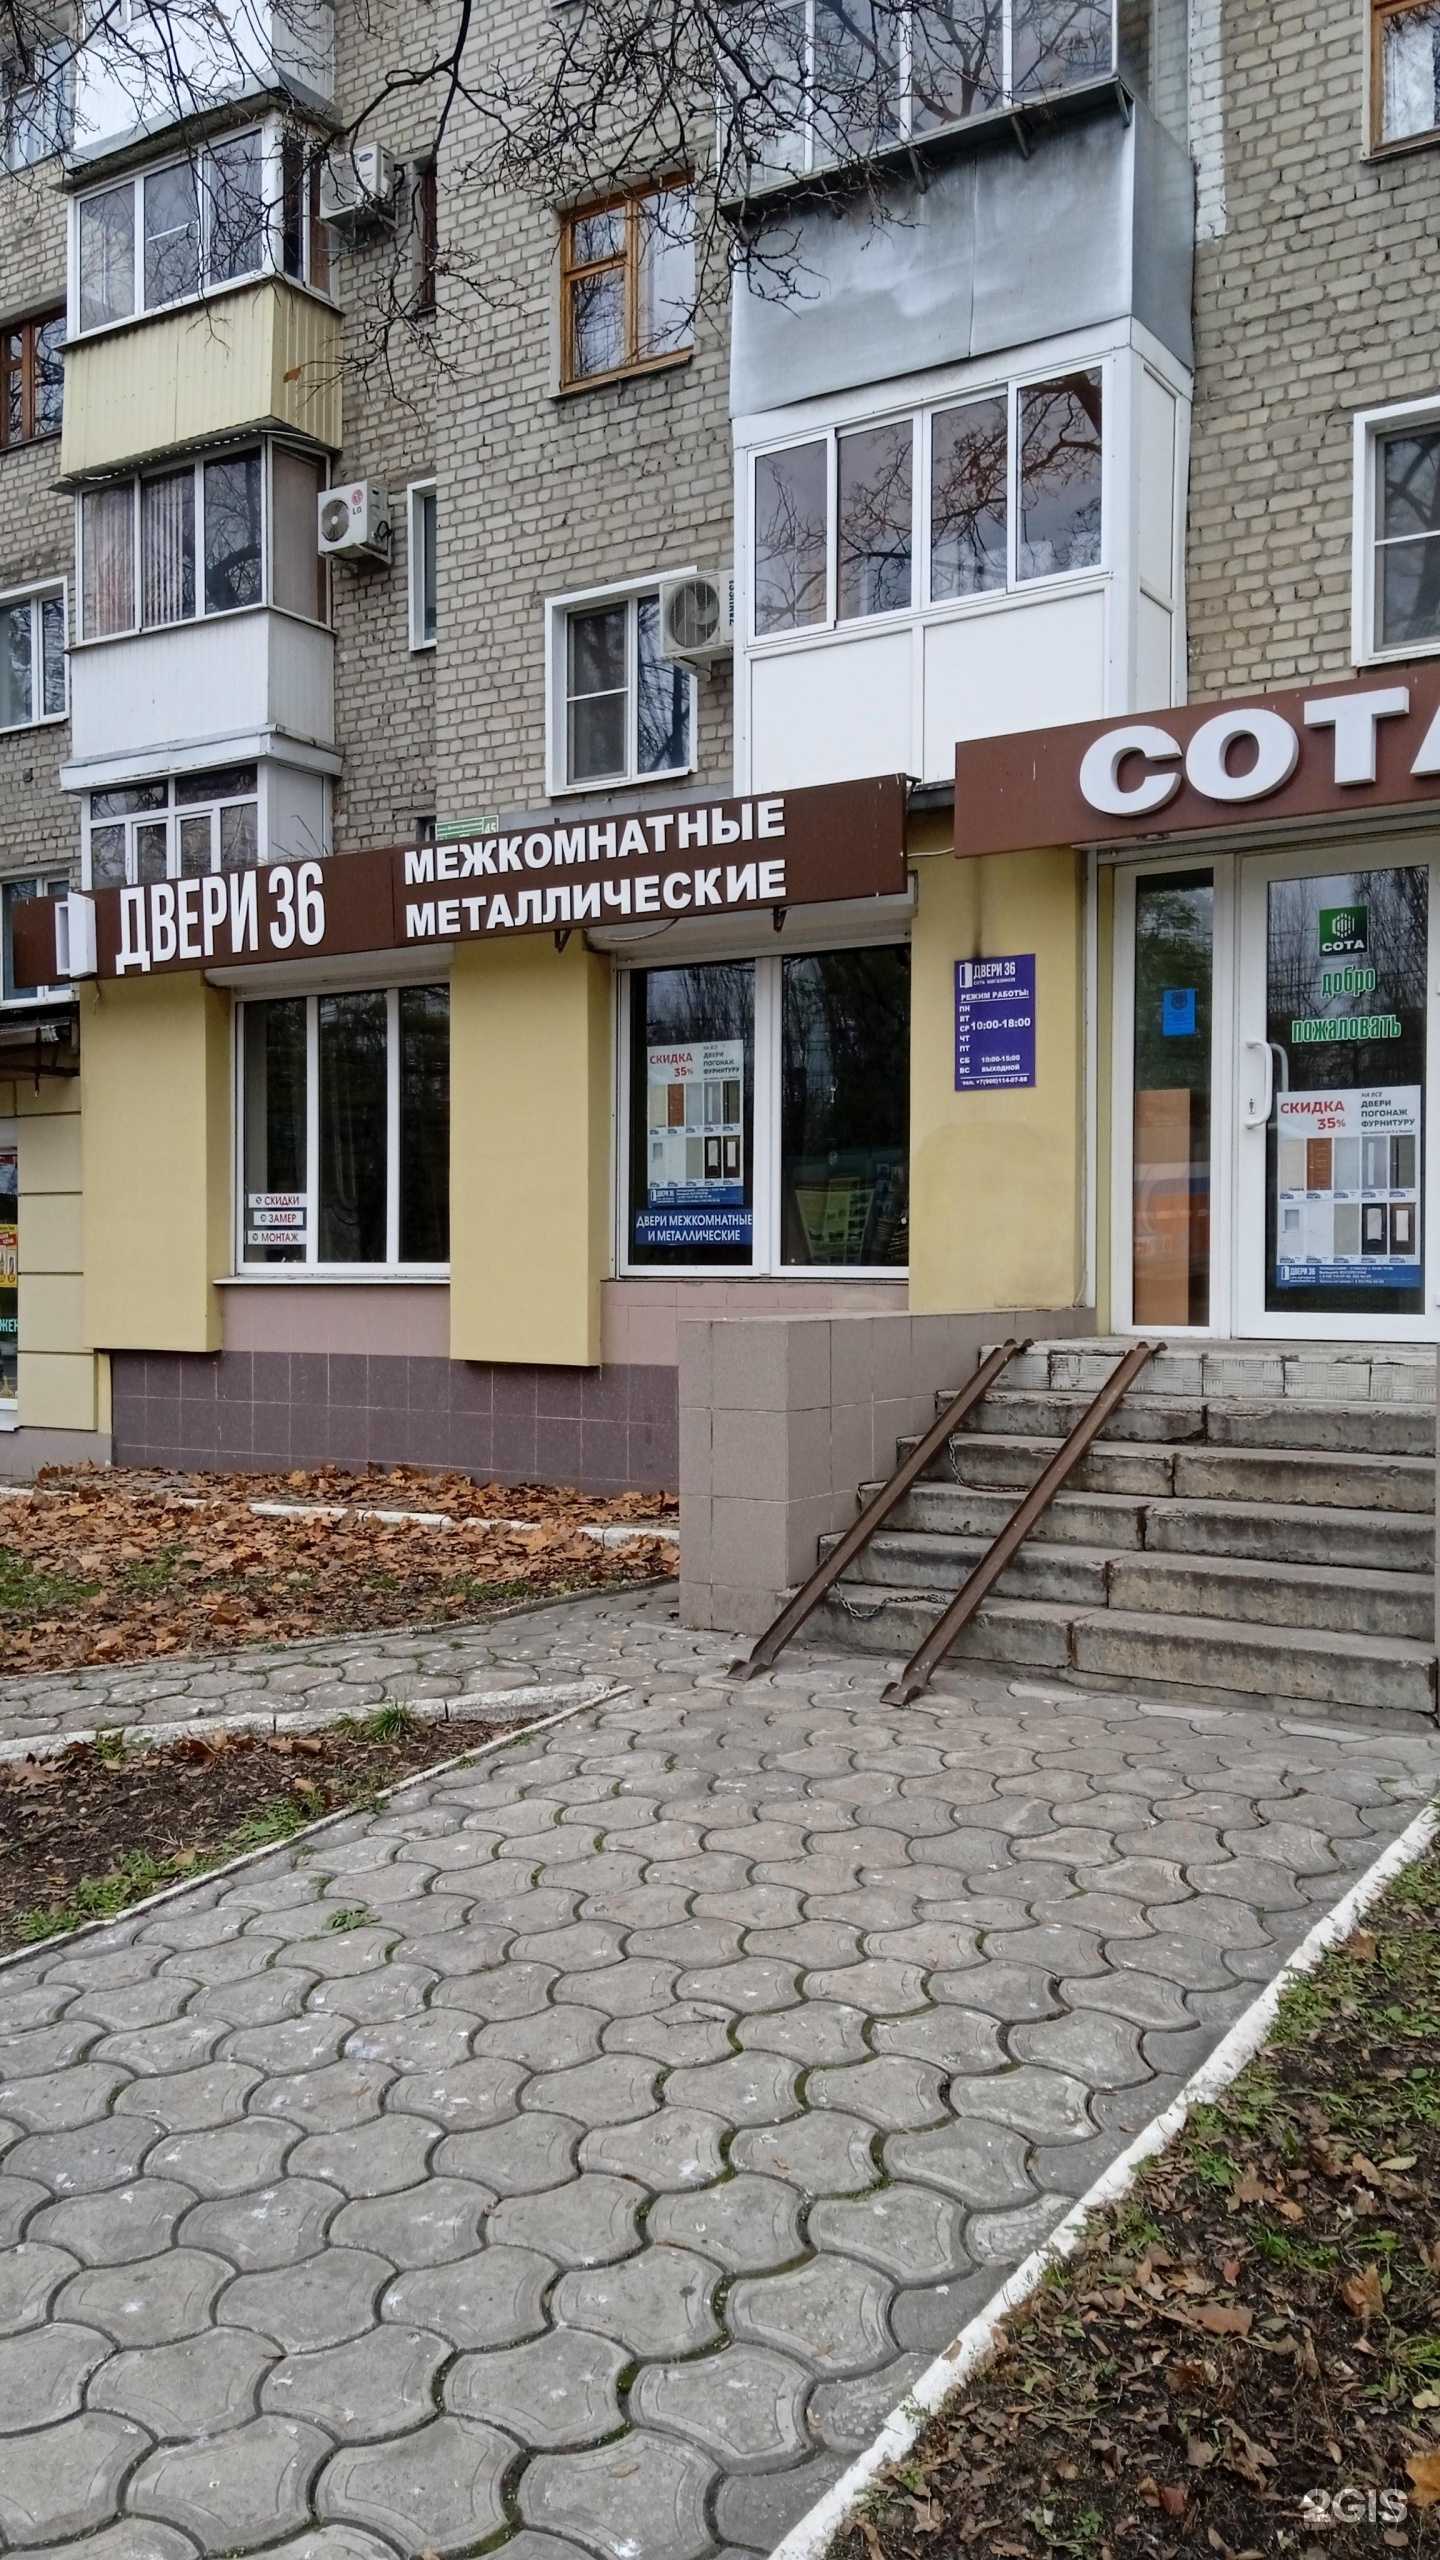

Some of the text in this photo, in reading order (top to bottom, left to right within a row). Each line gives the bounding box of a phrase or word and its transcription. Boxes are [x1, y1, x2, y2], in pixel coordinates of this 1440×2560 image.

[352, 506, 362, 515] LG
[404, 799, 785, 885] МЕЖКОМНАТНЫЕ
[406, 859, 787, 938] МЕТАЛЛИЧЕСКИЕ
[115, 861, 325, 976] ДВЕРИ 36
[1322, 939, 1365, 952] СОТА
[973, 961, 1016, 979] ДВЕРИ 36
[1321, 965, 1376, 998] добро
[961, 988, 1029, 1001] РЕЖИМ РАБОТЫ:
[971, 1018, 1031, 1030] 10:00-18:00
[1292, 1015, 1401, 1043] пожаловать
[649, 1052, 693, 1065] СКИДКА
[674, 1066, 694, 1078] 35%
[981, 1064, 1021, 1072] ВЫХОДНОЙ
[1280, 1101, 1345, 1115] СКИДКА
[1361, 1100, 1391, 1108] ДВЕРИ
[1361, 1109, 1408, 1117] ПОГОНАЖ
[1317, 1117, 1346, 1130] 35%
[1361, 1118, 1416, 1127] ФУРНИТУРУ
[264, 1196, 300, 1206] СКИДКИ
[268, 1213, 297, 1223] ЗАМЕР
[636, 1214, 753, 1228] ДВЕРИ МЕЖКОМНАТНЫЕ
[261, 1232, 298, 1242] МОНТАЖ
[647, 1229, 741, 1241] И МЕТАЛЛИЧЕСКИЕ
